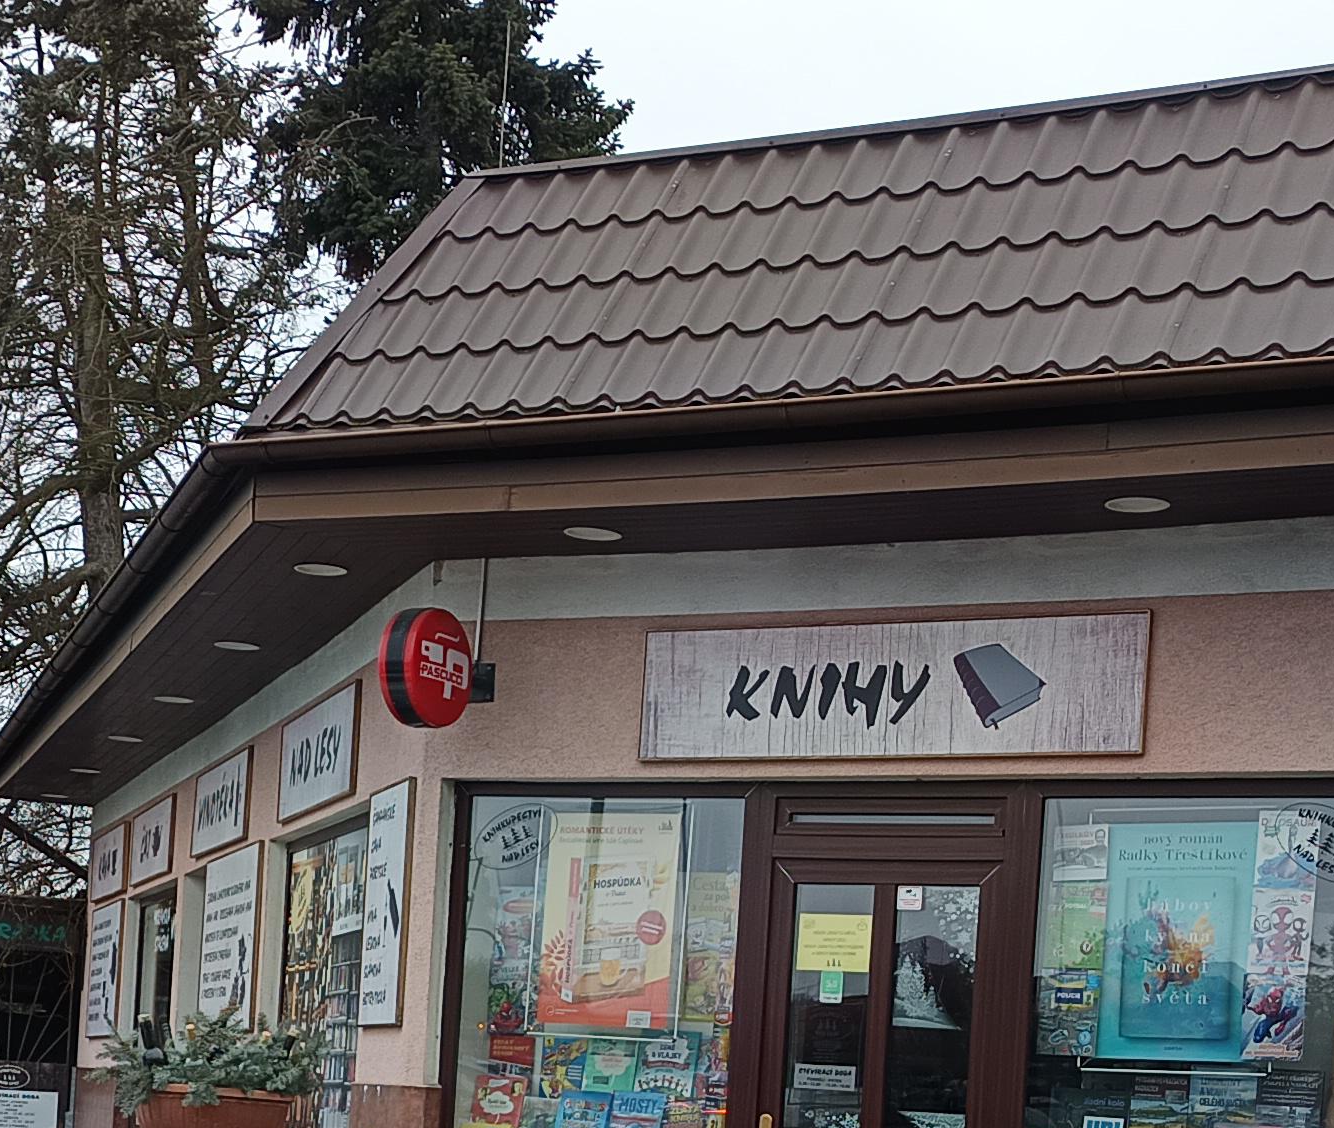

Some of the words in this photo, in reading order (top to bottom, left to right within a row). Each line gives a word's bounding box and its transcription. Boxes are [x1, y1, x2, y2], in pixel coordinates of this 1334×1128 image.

[726, 660, 931, 730] KNIHY
[289, 737, 312, 788] NAD
[314, 724, 342, 778] LESY
[1144, 835, 1173, 847] nový
[1119, 849, 1160, 863] Radky
[1293, 844, 1315, 862] NAD
[618, 1097, 659, 1115] MOSTY
